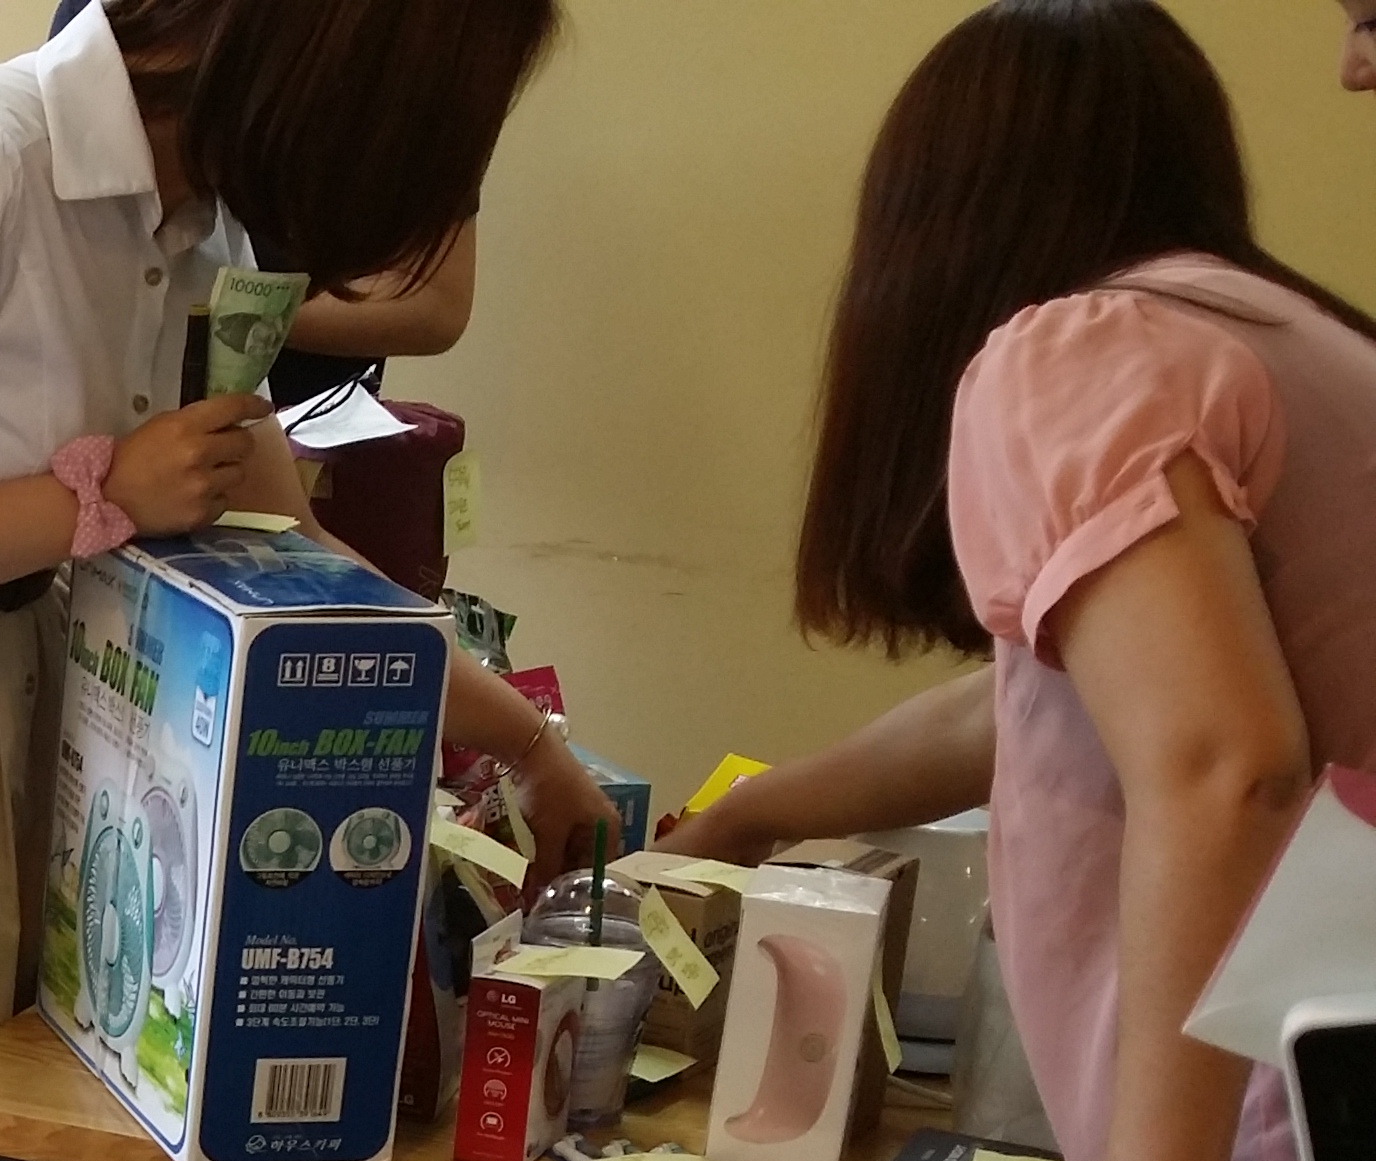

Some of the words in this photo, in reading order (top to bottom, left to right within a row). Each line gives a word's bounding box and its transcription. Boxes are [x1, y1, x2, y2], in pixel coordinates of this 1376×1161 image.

[229, 275, 273, 298] 10000
[313, 728, 425, 757] BOX-FAN
[277, 757, 330, 772] 유니맥스
[334, 757, 374, 772] 박스형
[378, 757, 416, 772] 선풍기
[241, 947, 334, 970] UMF-B754
[501, 993, 516, 1005] LG
